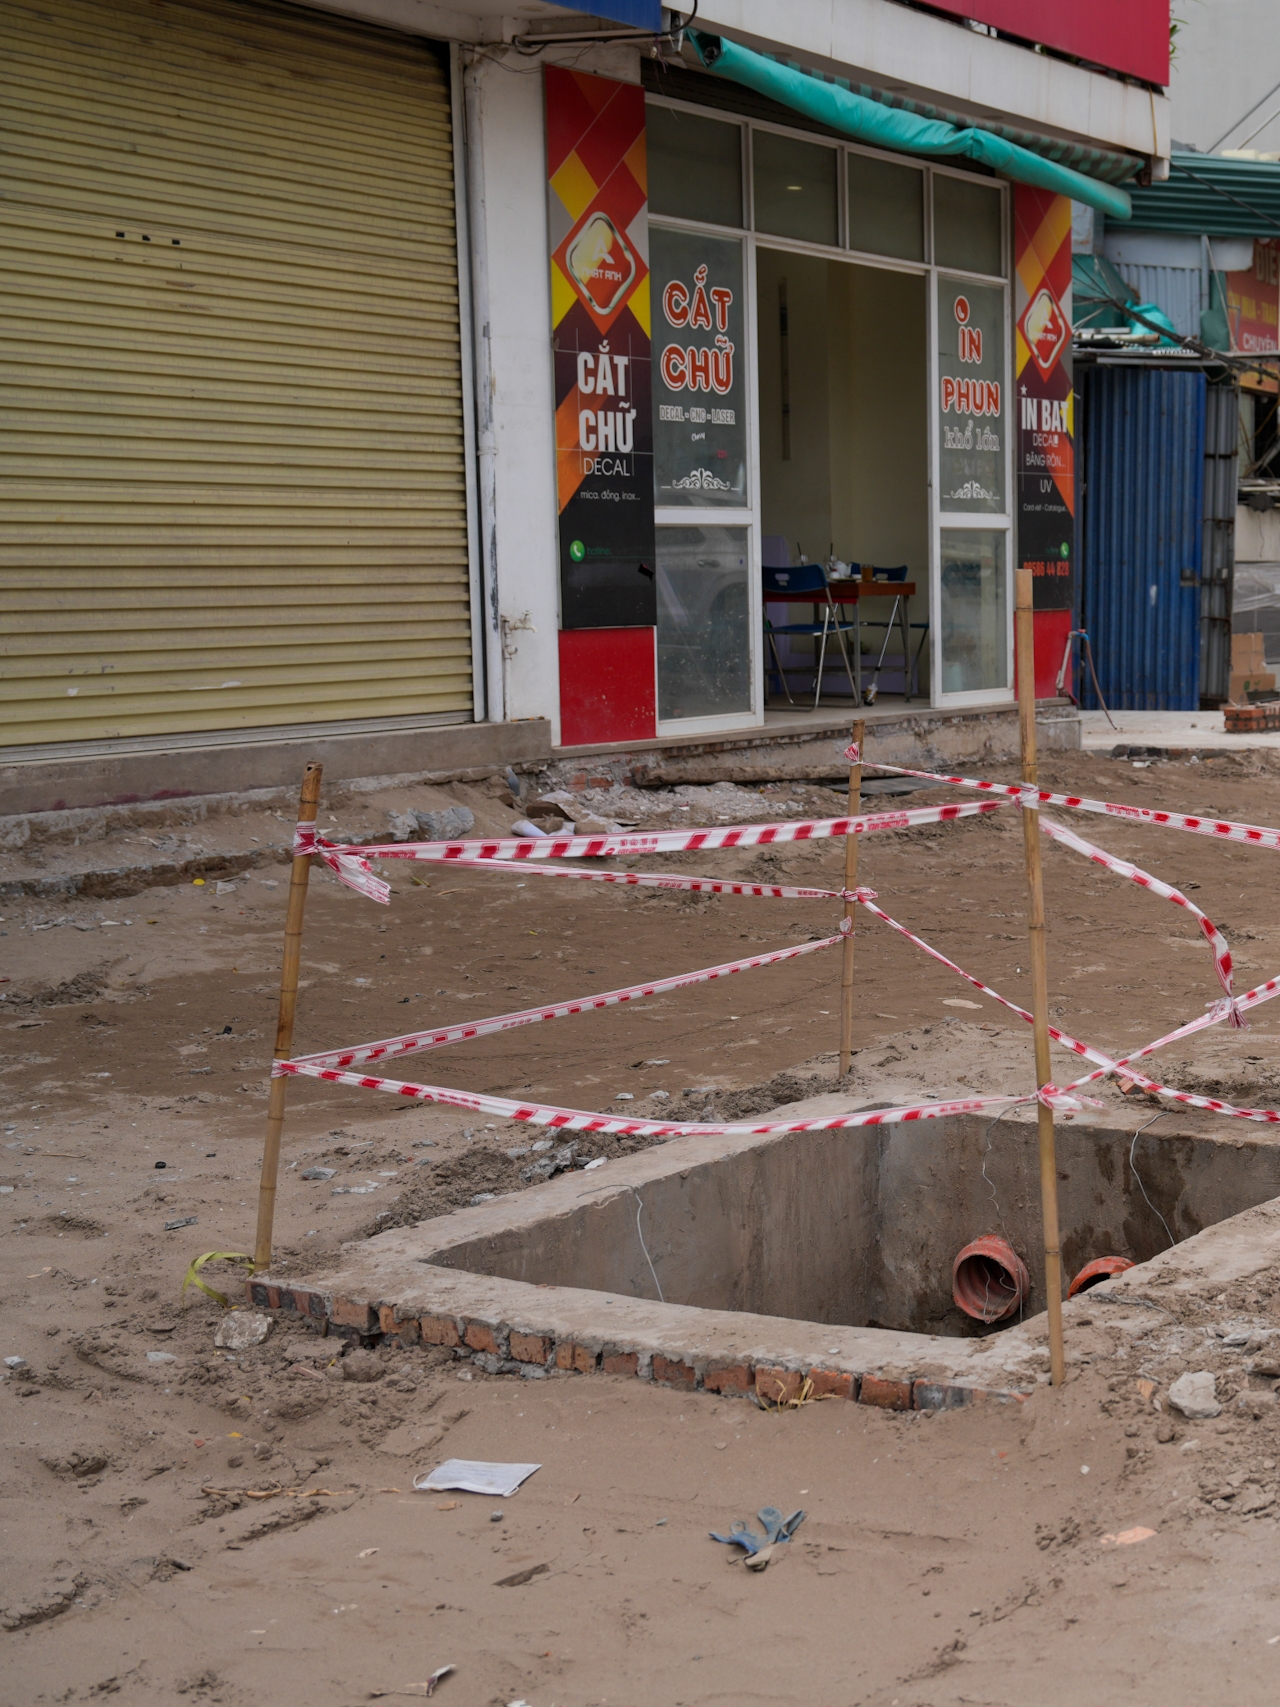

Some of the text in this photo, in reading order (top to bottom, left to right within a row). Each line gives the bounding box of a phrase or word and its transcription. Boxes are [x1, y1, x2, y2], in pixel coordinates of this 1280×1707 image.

[663, 264, 732, 331] CẮT
[577, 340, 628, 397] CẮT
[661, 334, 734, 394] CHỮ
[660, 405, 685, 422] DECAL
[690, 407, 706, 423] CNC
[711, 408, 736, 425] LASER
[941, 376, 1000, 417] PHUN
[1021, 397, 1038, 430] IN
[579, 402, 636, 453] CHỮ
[944, 420, 1000, 451] khổ lớn
[583, 458, 630, 476] DECAL
[1040, 479, 1052, 493] UV
